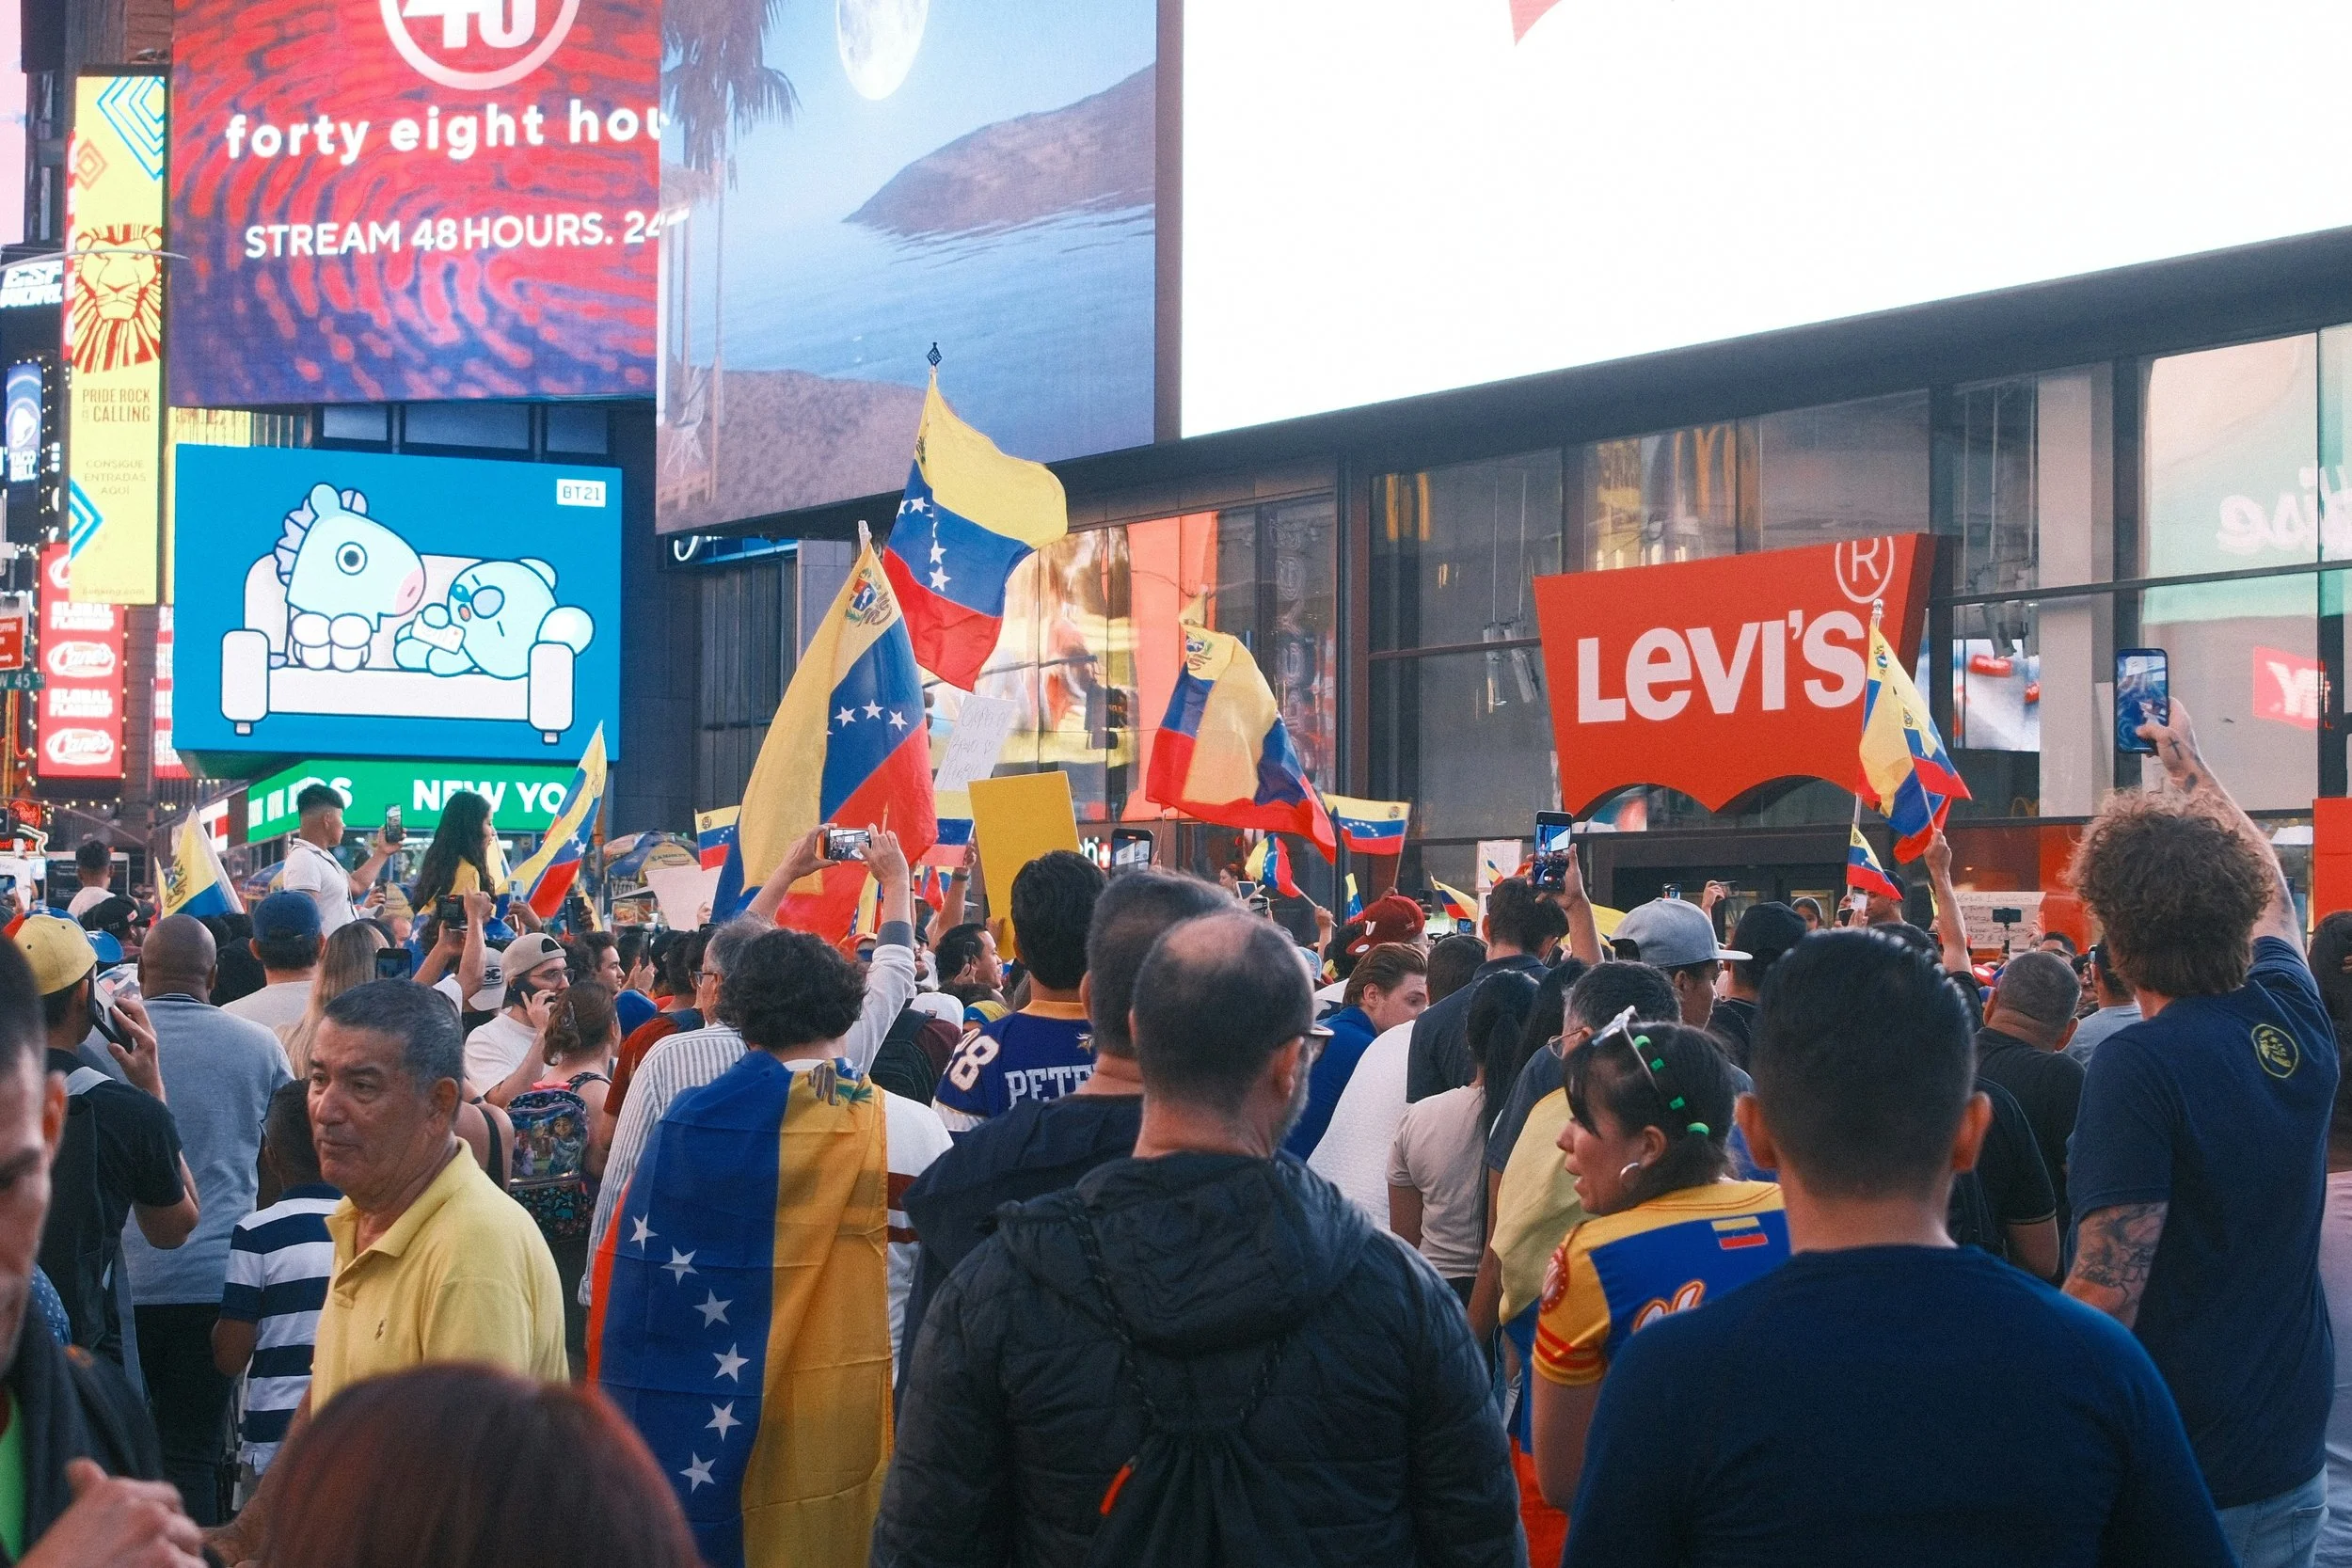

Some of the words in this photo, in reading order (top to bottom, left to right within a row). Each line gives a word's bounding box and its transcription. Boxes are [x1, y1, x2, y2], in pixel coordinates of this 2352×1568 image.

[226, 114, 370, 166] forty
[389, 103, 544, 160] eight
[246, 218, 401, 259] STREAM
[82, 388, 118, 403] PRIDE
[119, 388, 151, 403] ROCK
[93, 405, 151, 422] CALLING
[86, 459, 144, 468] CONSIGUE
[84, 472, 147, 482] ENTRADAS
[562, 485, 601, 500] BT21
[15, 673, 31, 689] 45
